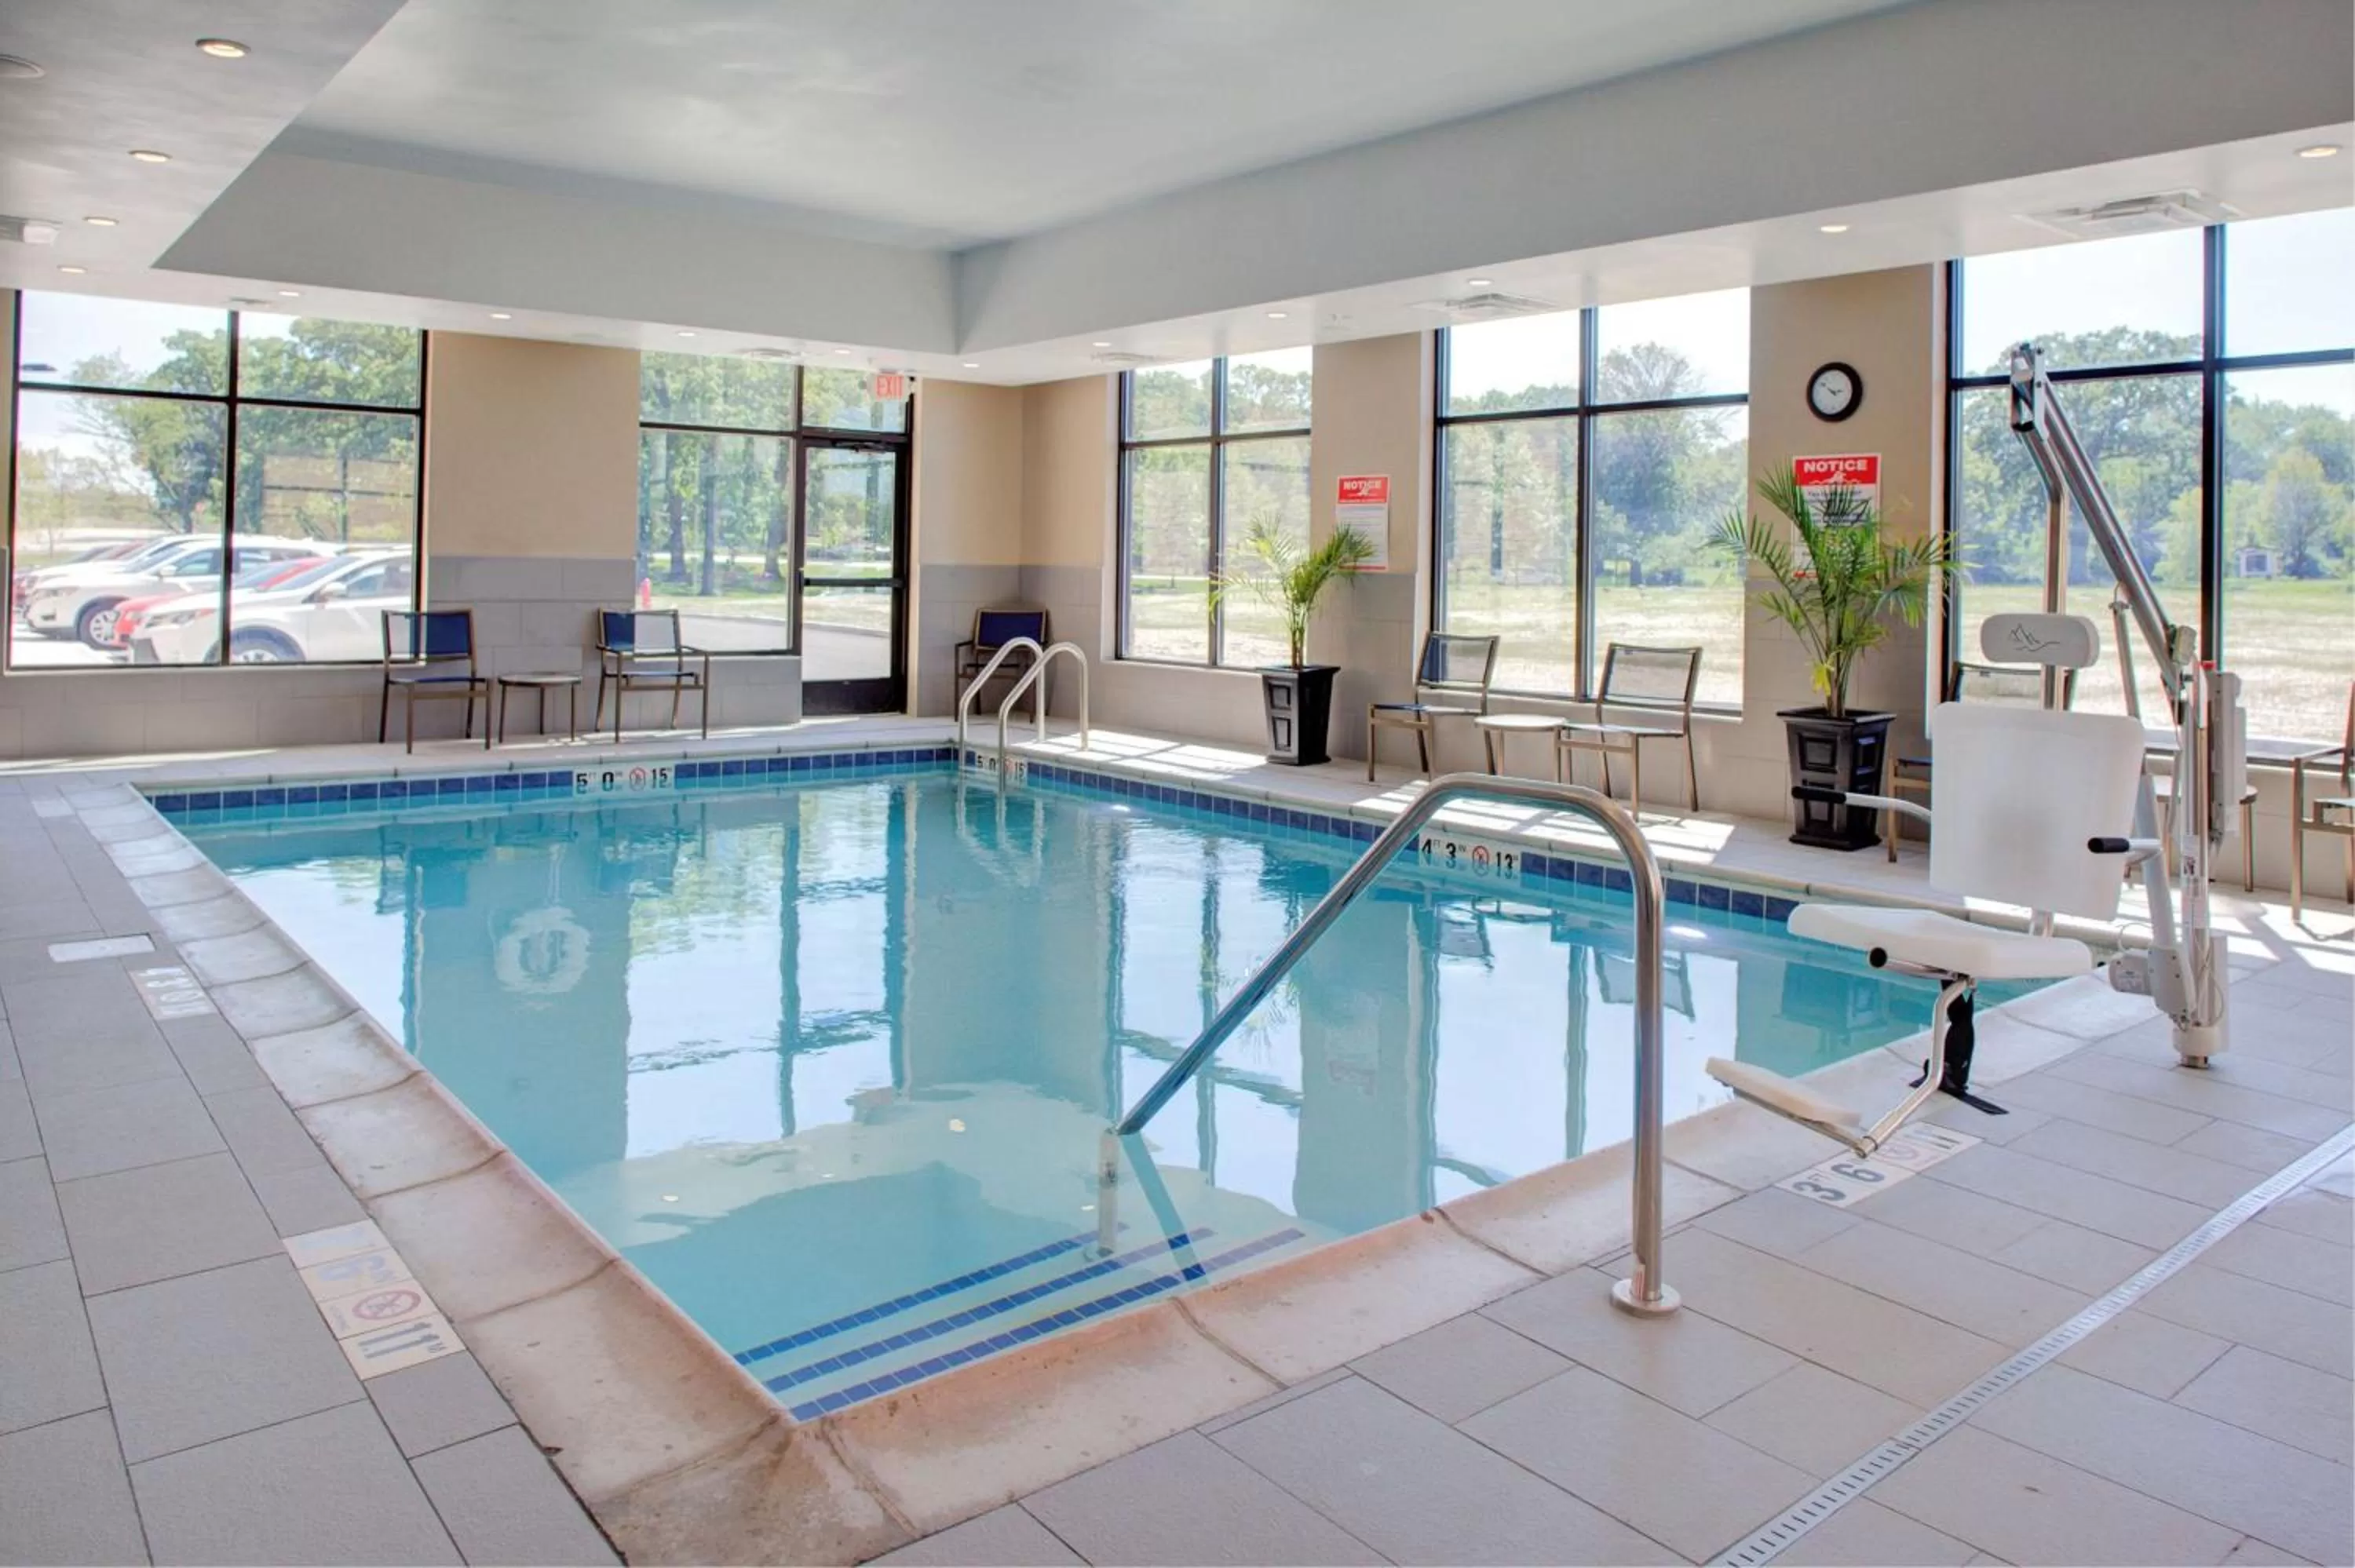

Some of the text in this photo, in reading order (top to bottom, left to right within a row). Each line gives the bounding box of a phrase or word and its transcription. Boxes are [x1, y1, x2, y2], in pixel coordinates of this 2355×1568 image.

[876, 375, 904, 398] EXIT
[1803, 459, 1868, 472] NOTICE
[1343, 480, 1382, 490] NOTICE
[576, 772, 588, 793] 5
[602, 771, 614, 791] 0
[1445, 842, 1456, 868] 3
[1792, 1181, 1846, 1202] 3
[1831, 1164, 1884, 1183] 6
